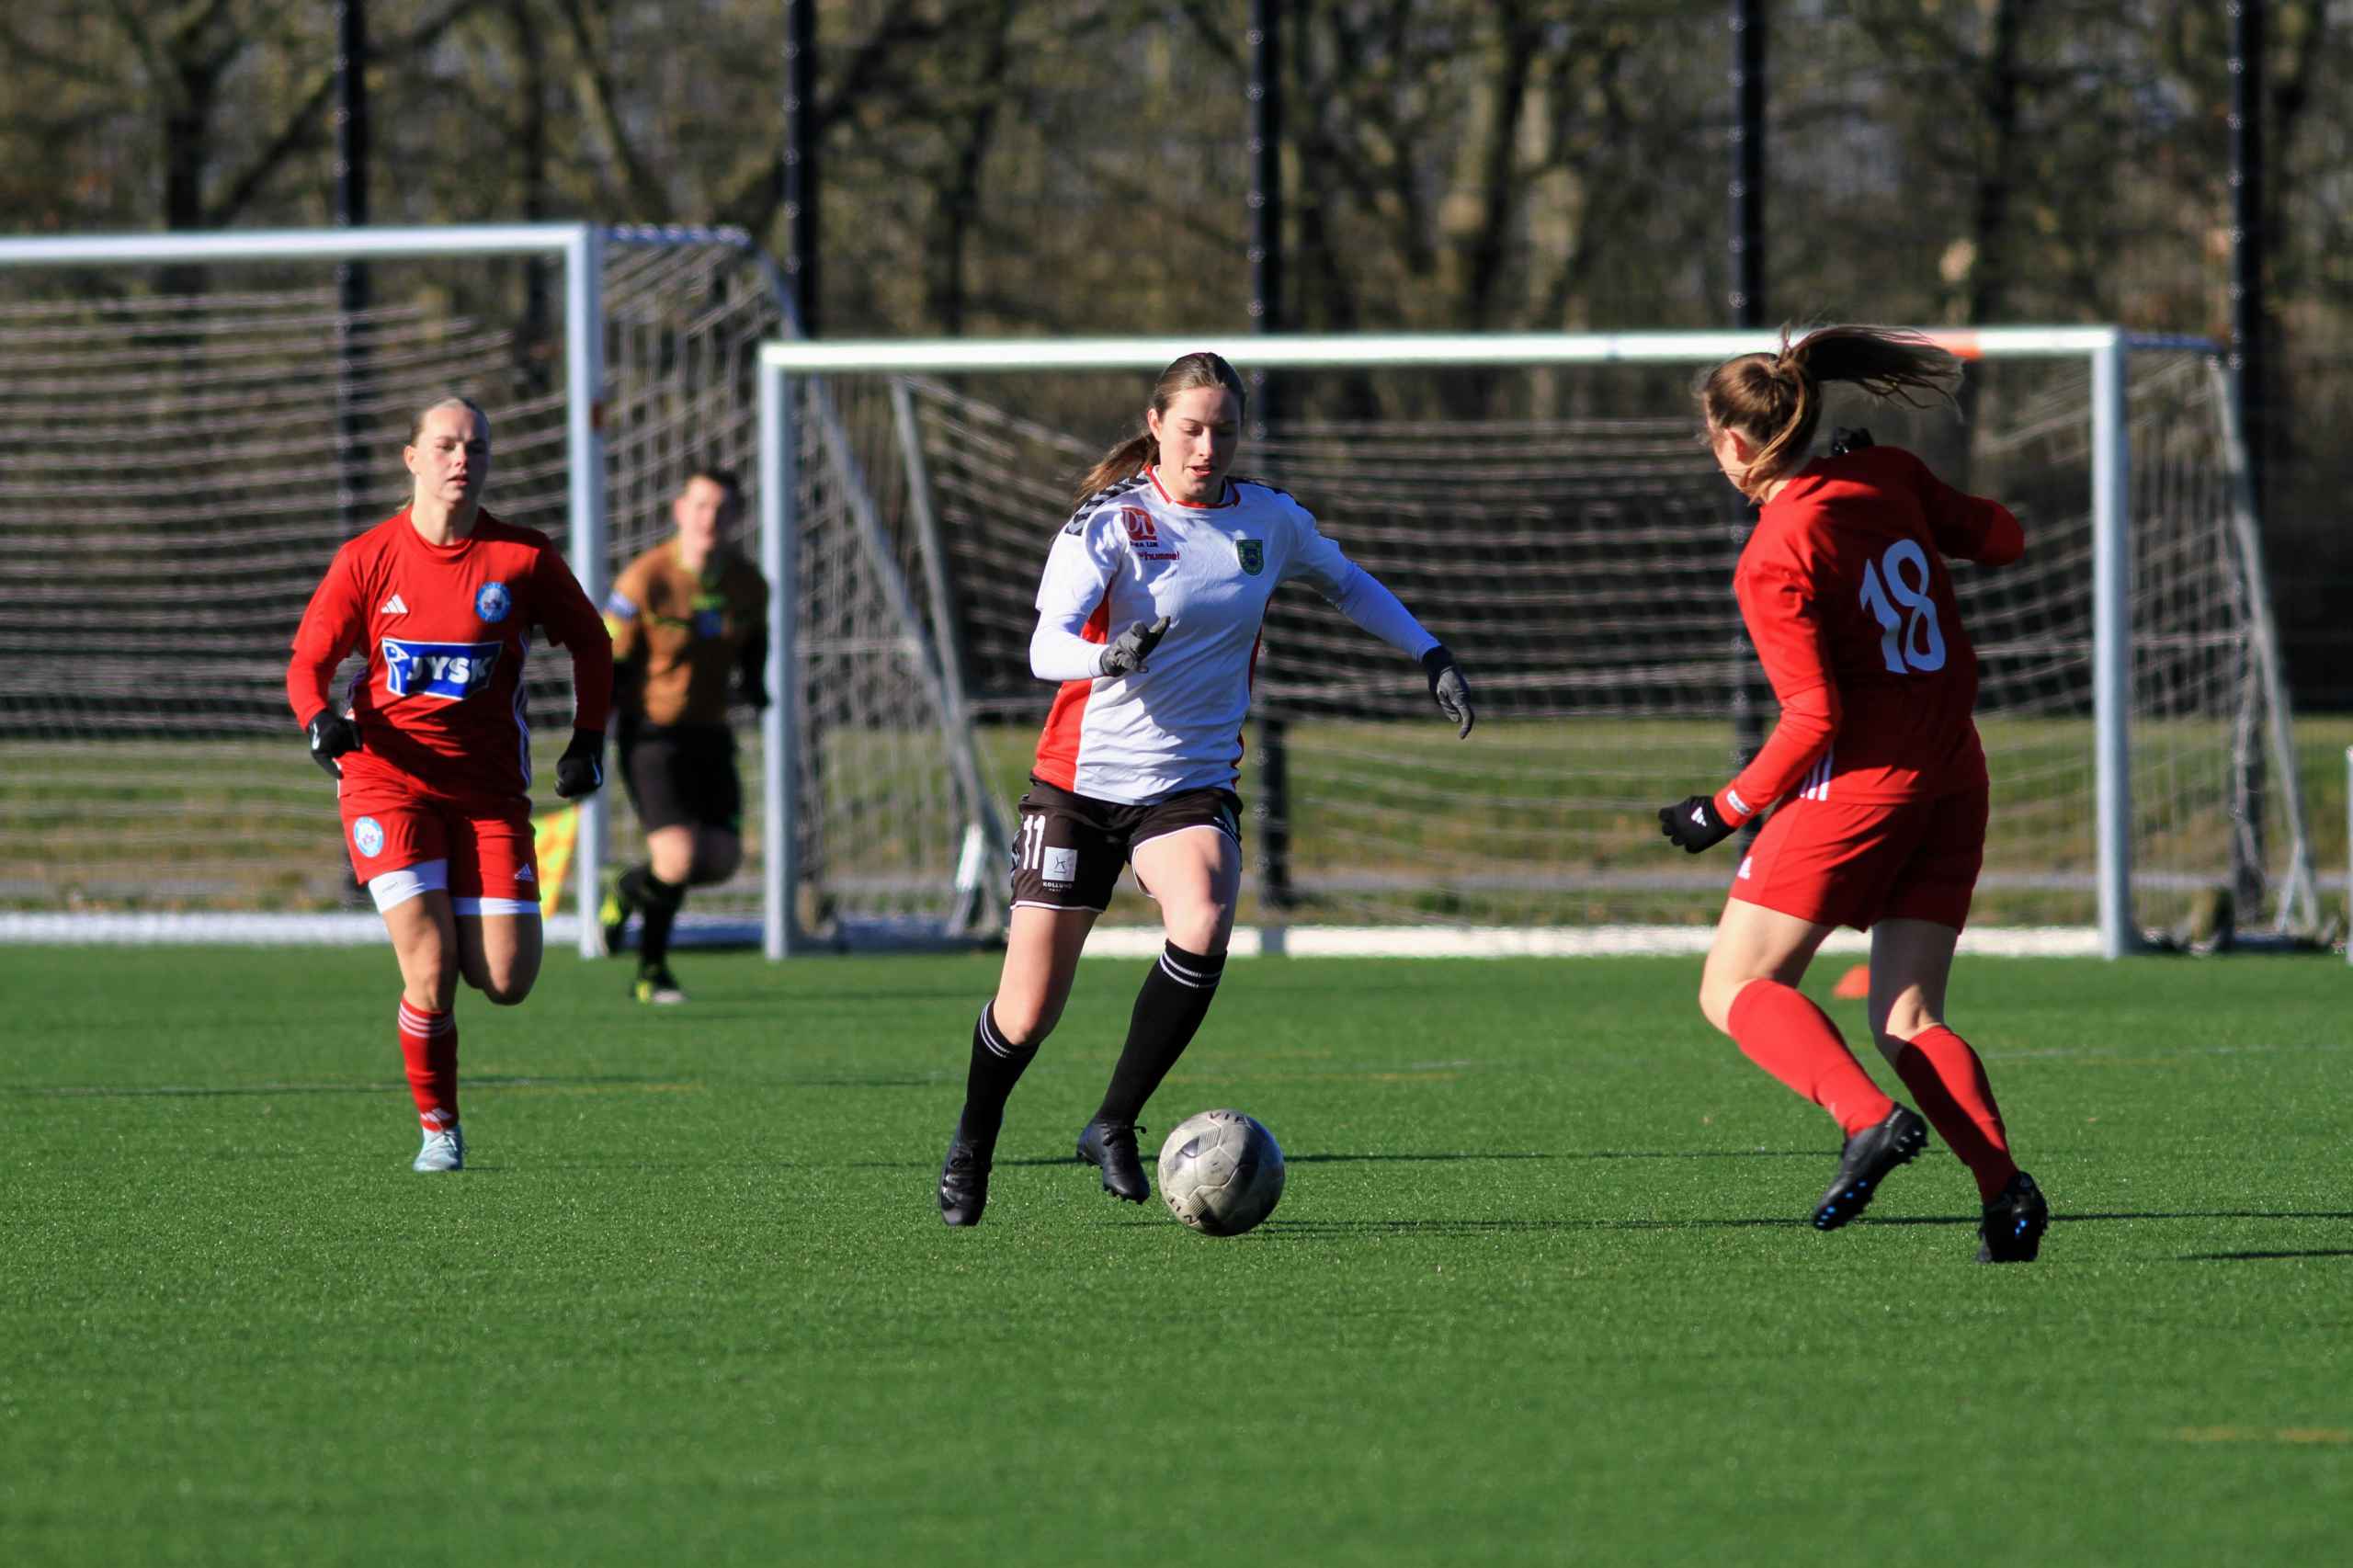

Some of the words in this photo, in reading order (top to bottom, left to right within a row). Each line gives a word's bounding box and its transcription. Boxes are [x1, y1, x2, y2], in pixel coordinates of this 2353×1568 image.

[1859, 539, 1946, 674] 18
[406, 655, 491, 683] JYSK
[1023, 814, 1046, 870] 11
